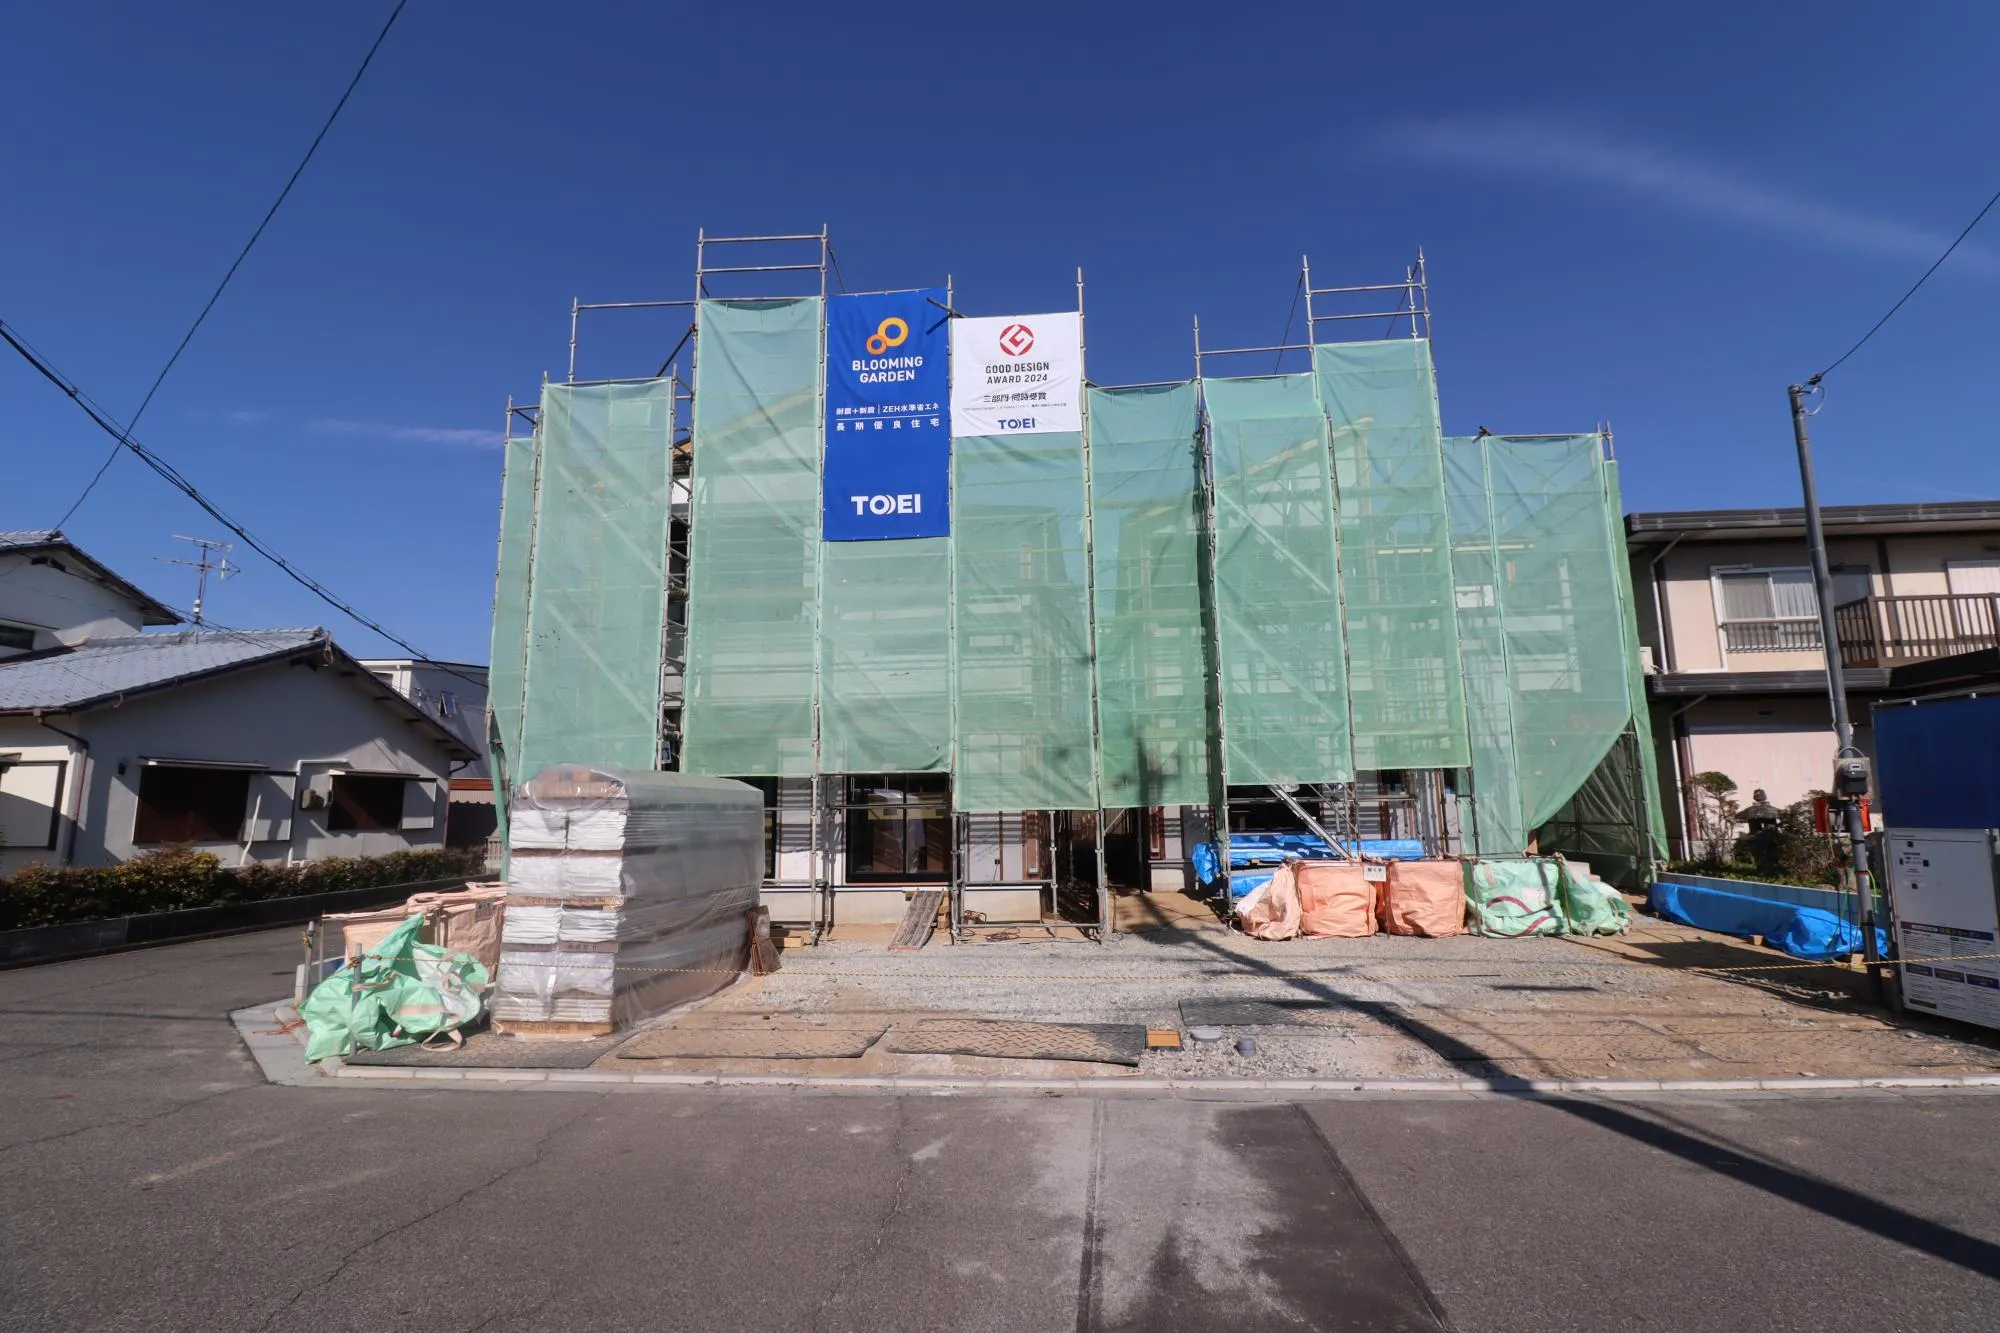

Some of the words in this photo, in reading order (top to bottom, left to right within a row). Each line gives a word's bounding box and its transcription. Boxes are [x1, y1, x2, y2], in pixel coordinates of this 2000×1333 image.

[852, 356, 923, 371] BLOOMING
[985, 364, 1012, 374] GOOD
[1014, 361, 1050, 372] DESIGN
[859, 370, 916, 384] GARDEN
[986, 374, 1022, 385] AWARD
[1024, 373, 1049, 383] 2024
[850, 493, 922, 516] TOEI
